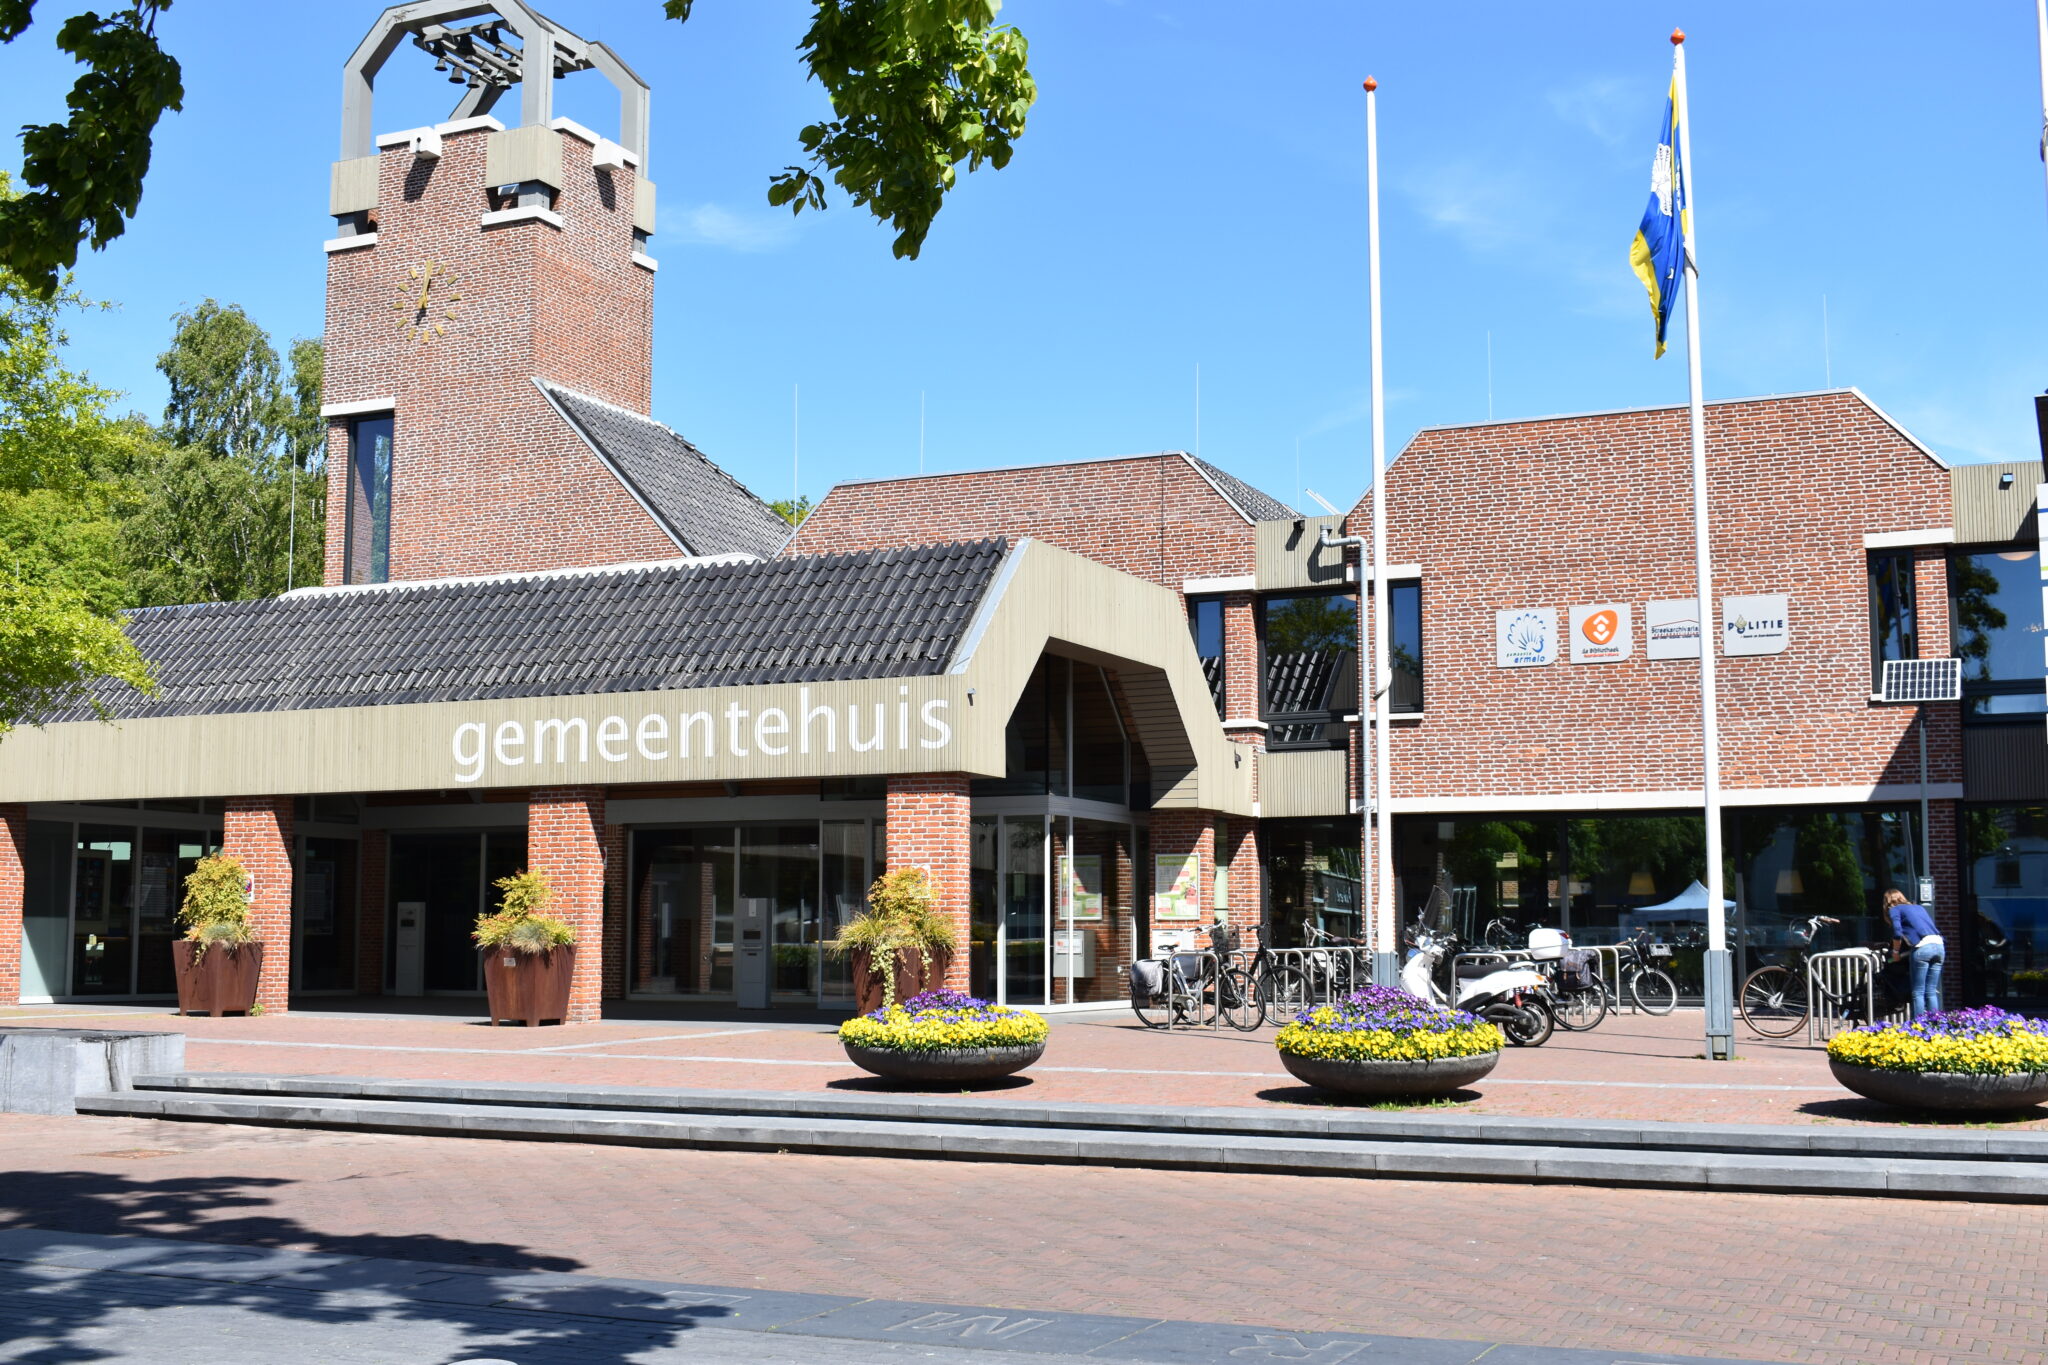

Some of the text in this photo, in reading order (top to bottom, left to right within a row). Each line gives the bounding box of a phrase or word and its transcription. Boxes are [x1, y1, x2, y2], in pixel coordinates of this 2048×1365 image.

[1727, 620, 1784, 634] POLITIE
[1514, 655, 1546, 663] ermelo
[451, 685, 952, 783] gemeentehuis
